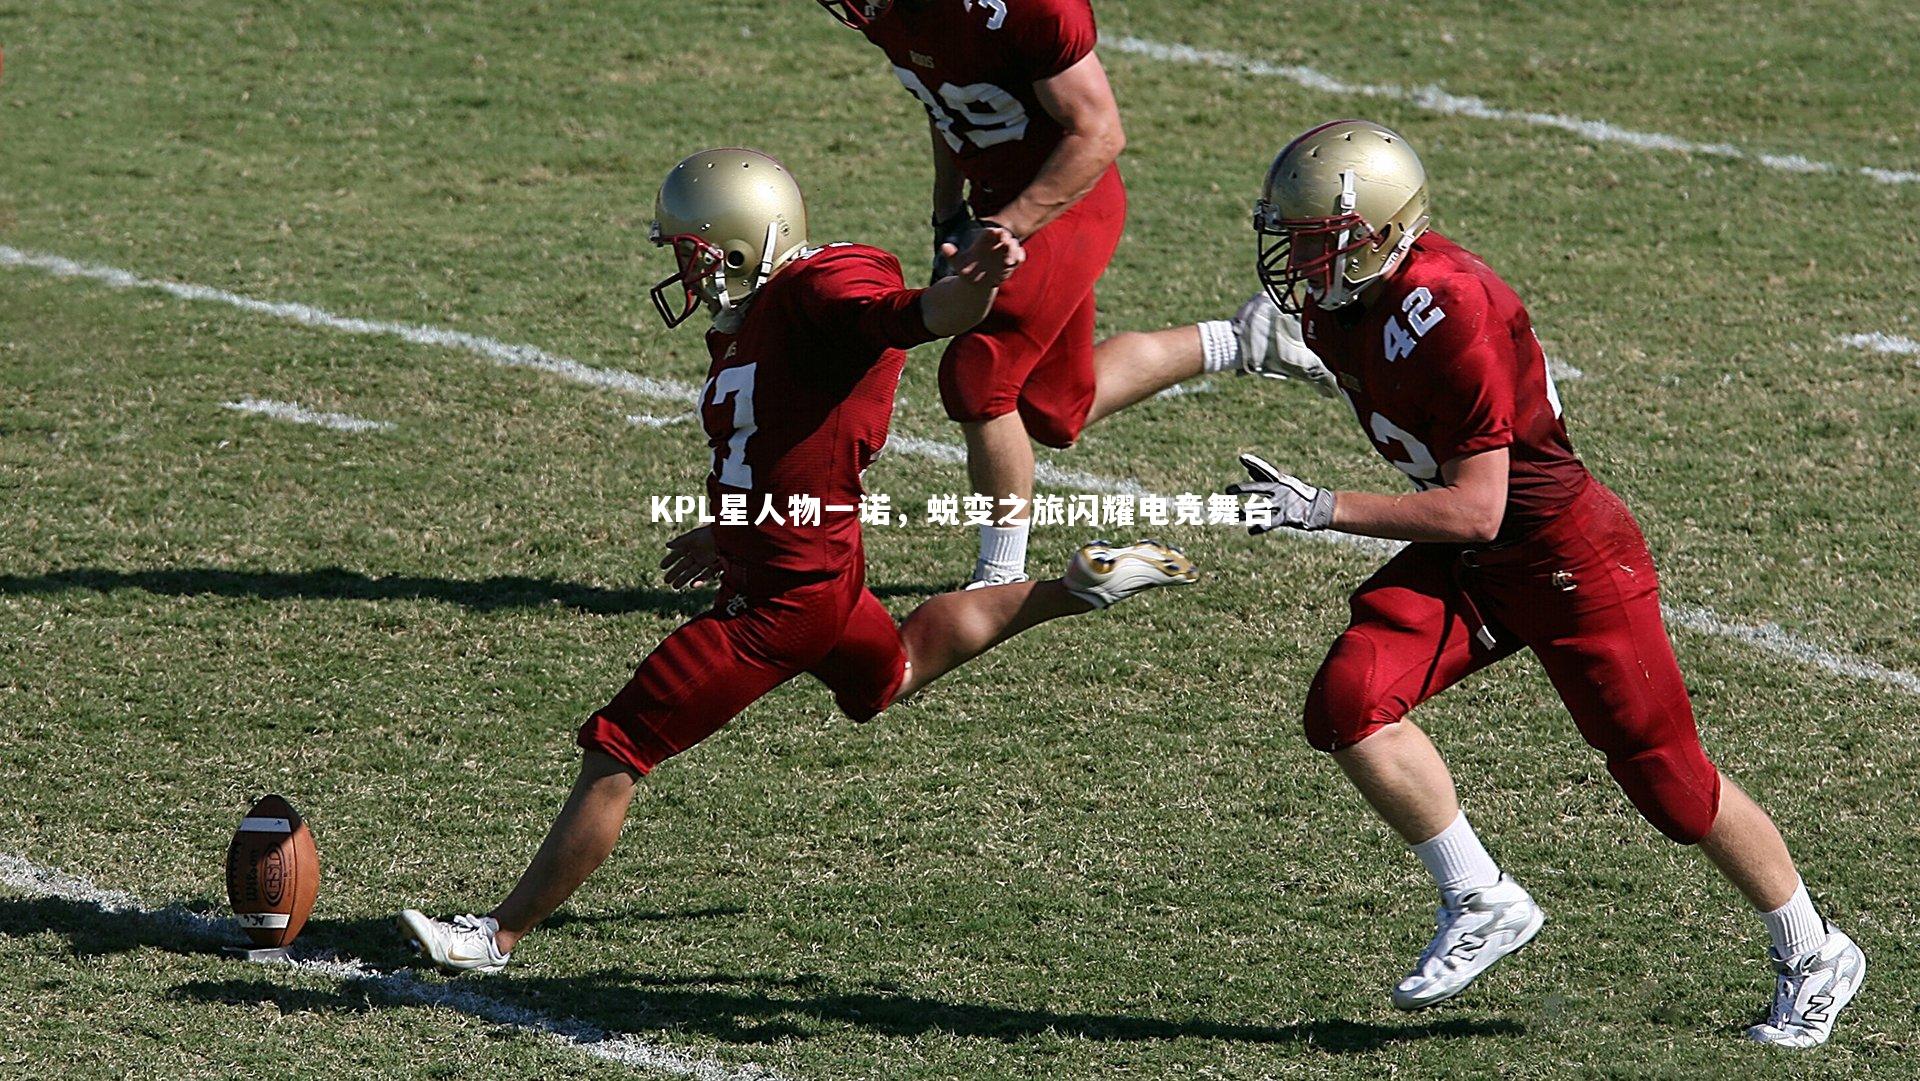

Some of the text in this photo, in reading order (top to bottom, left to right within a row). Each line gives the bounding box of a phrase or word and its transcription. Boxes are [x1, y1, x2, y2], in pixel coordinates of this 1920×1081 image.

[1384, 286, 1446, 362] 42
[700, 362, 758, 490] 7
[1804, 995, 1834, 1021] N
